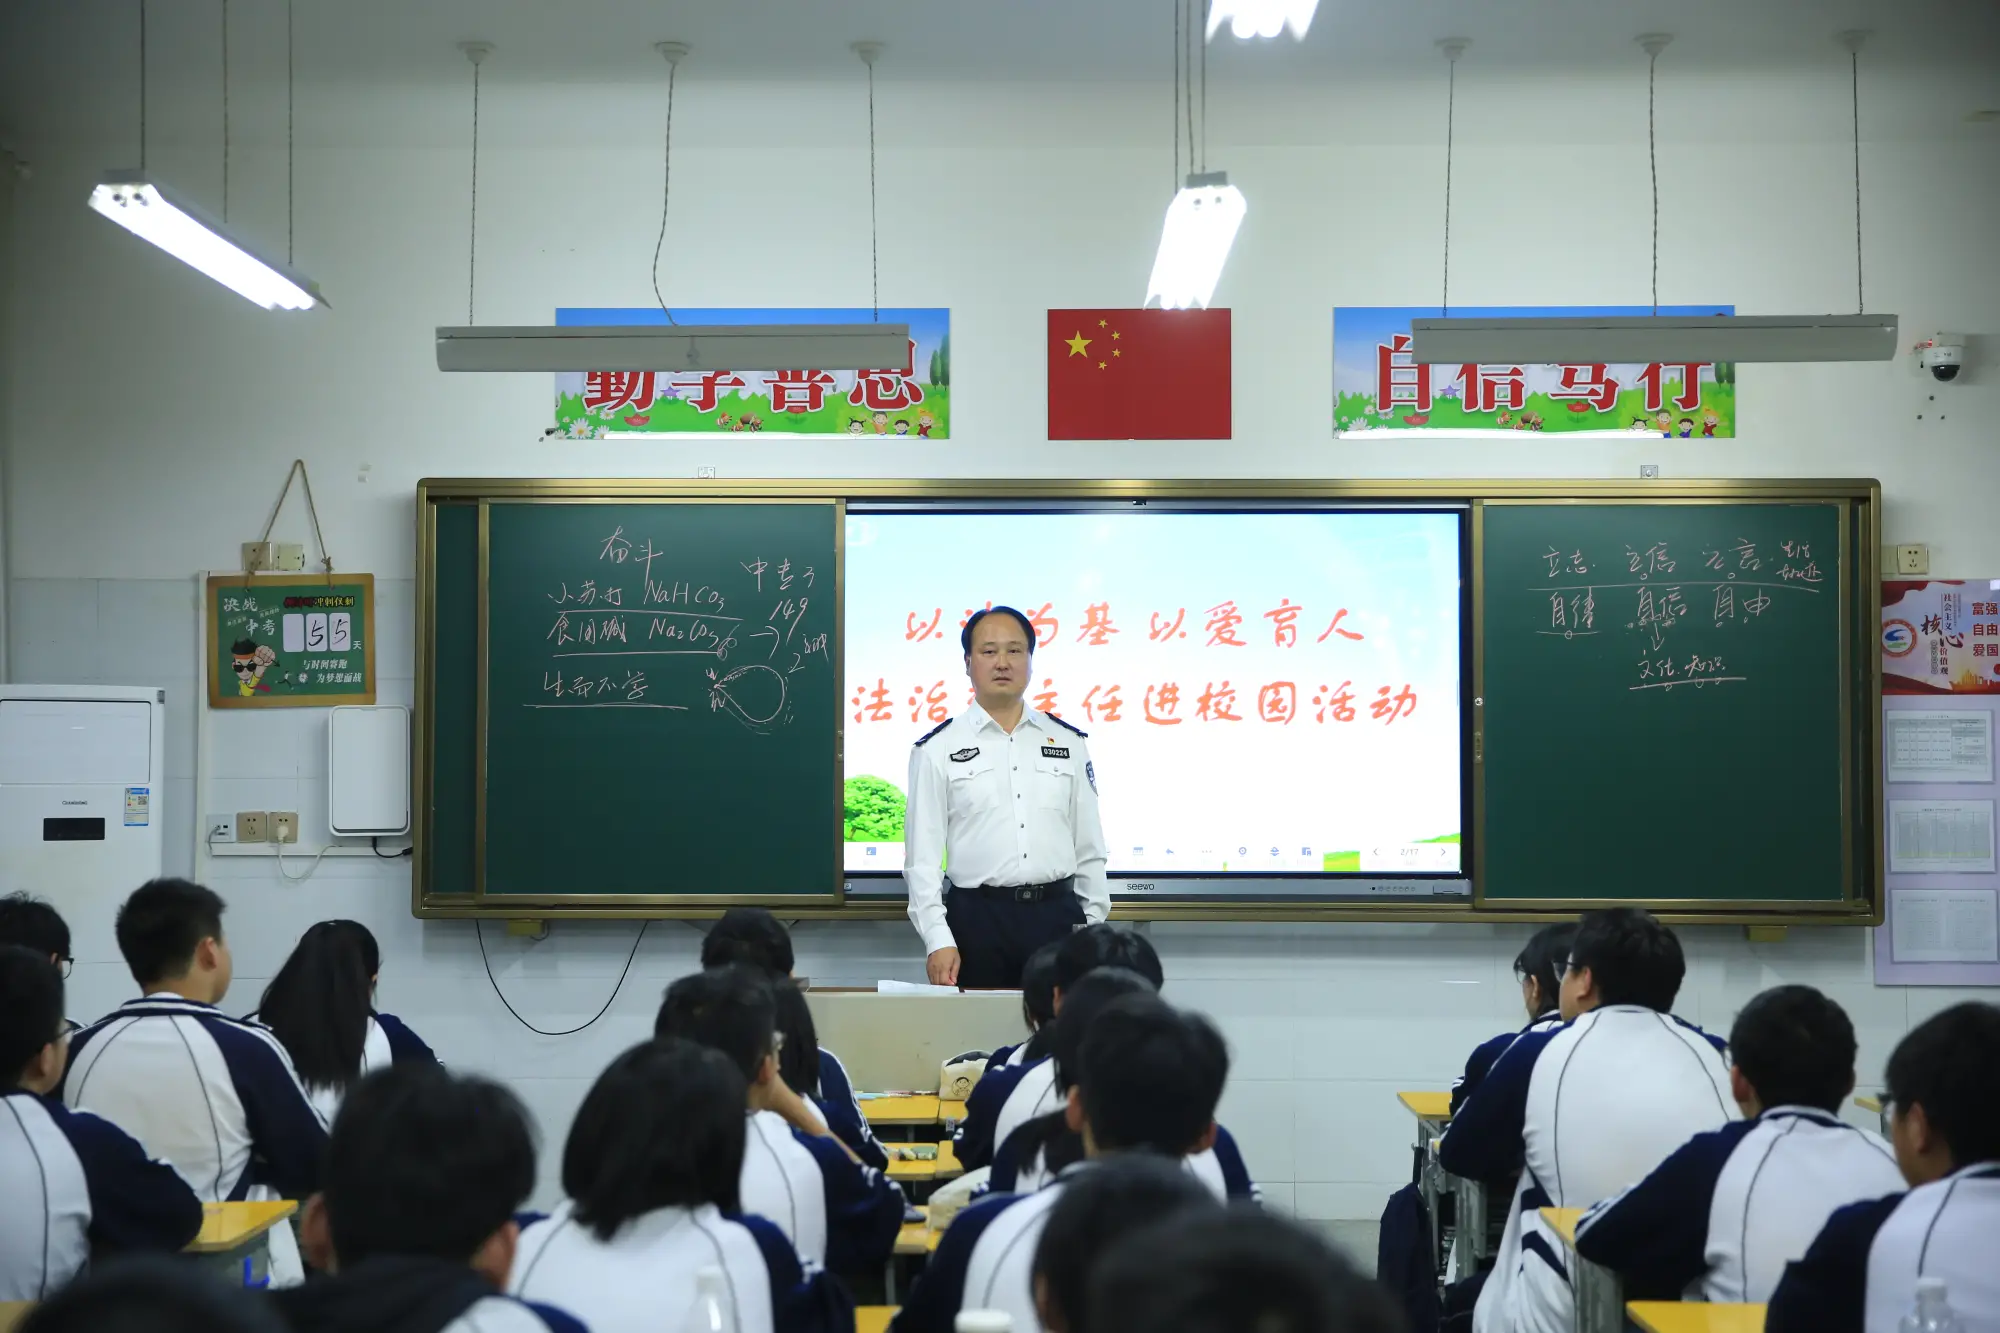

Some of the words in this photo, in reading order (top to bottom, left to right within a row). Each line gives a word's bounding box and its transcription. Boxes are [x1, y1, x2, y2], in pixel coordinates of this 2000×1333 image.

[223, 597, 259, 612] 决战
[1972, 602, 1998, 615] 富强
[245, 618, 275, 637] 中考
[905, 601, 1120, 648] 以为基
[1149, 598, 1364, 648] 以爱育人
[1973, 623, 1998, 636] 自由
[1920, 613, 1964, 648] 核心
[353, 640, 362, 650] 天
[1972, 643, 1999, 657] 爱国
[303, 659, 348, 670] 与时间赛跑
[1940, 647, 1949, 675] 价值观
[316, 672, 363, 683] 为梦想而战
[853, 678, 1418, 727] 法治主任进校园活动
[1043, 748, 1068, 757] 030224
[1400, 848, 1419, 857] 2/17
[1126, 882, 1155, 891] seewo
